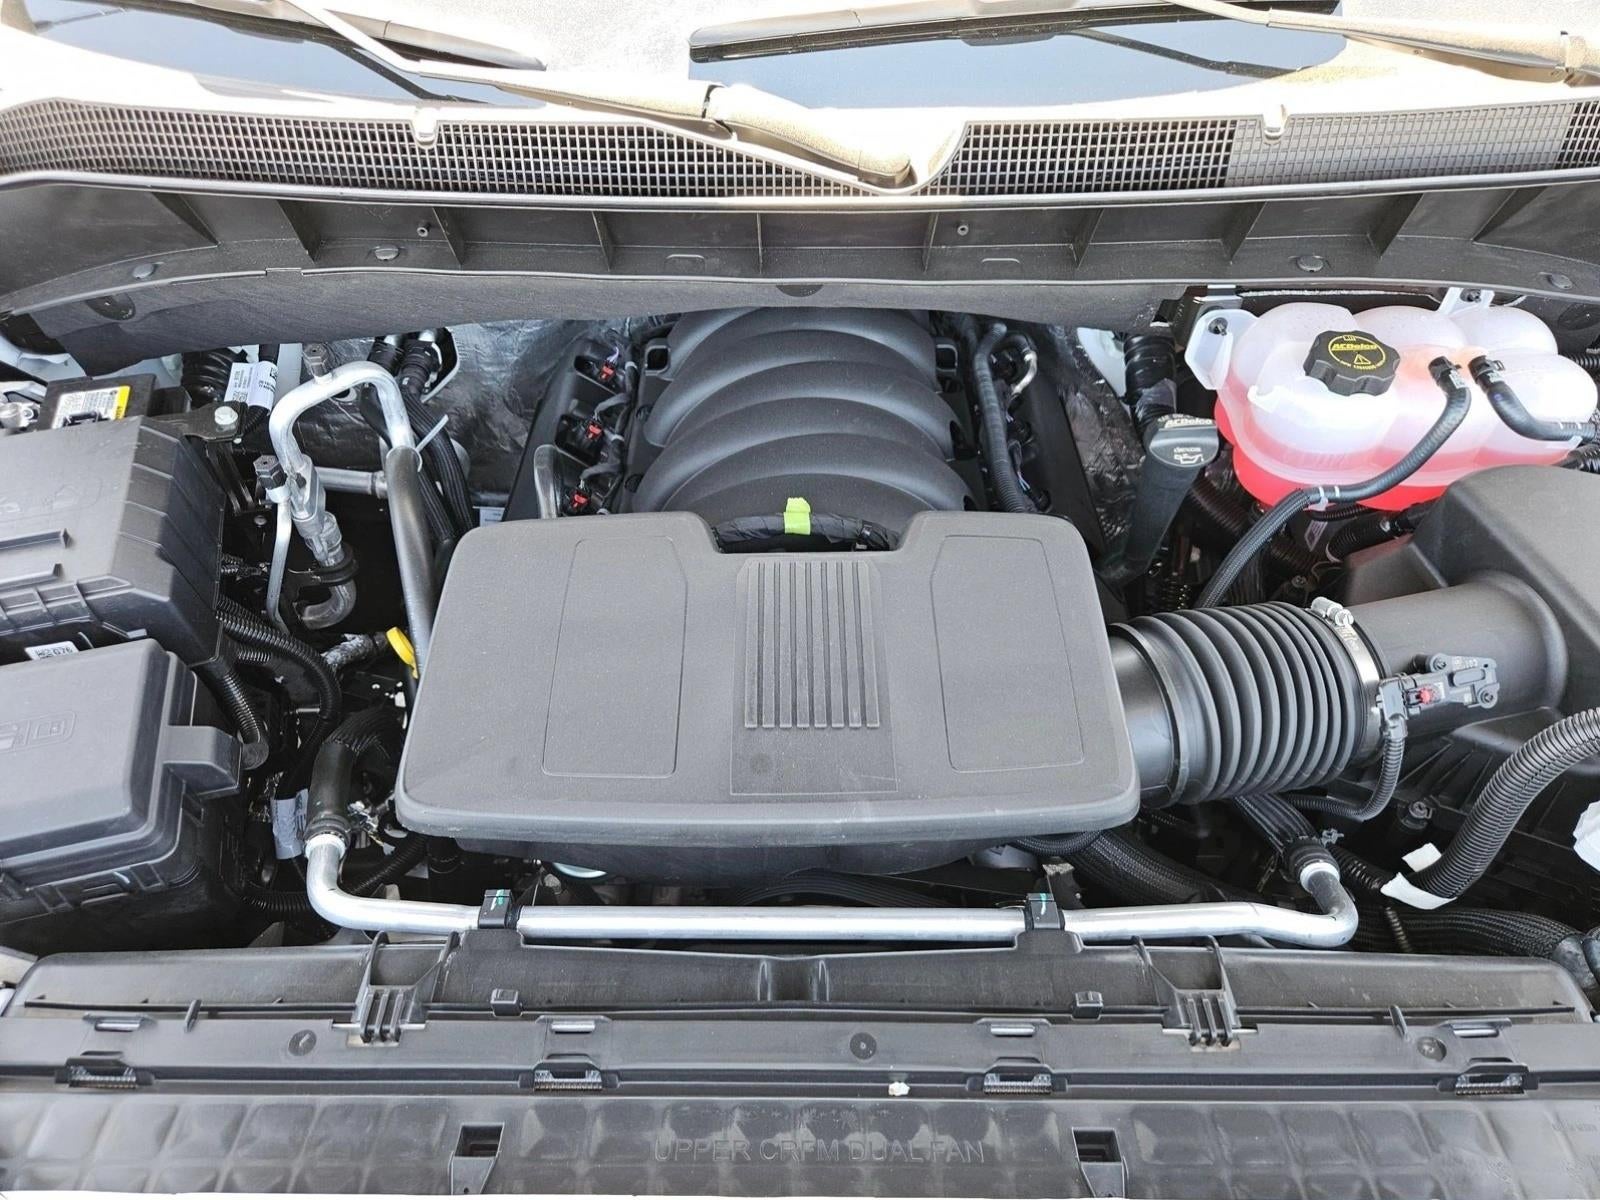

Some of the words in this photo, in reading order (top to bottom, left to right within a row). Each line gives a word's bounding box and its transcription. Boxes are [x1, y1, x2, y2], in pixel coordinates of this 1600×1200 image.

[1331, 343, 1377, 351] ACDelco
[1164, 418, 1213, 429] ACDelco
[654, 1137, 752, 1161] UPPER
[849, 1139, 924, 1163] DUAL
[930, 1140, 985, 1163] FAN
